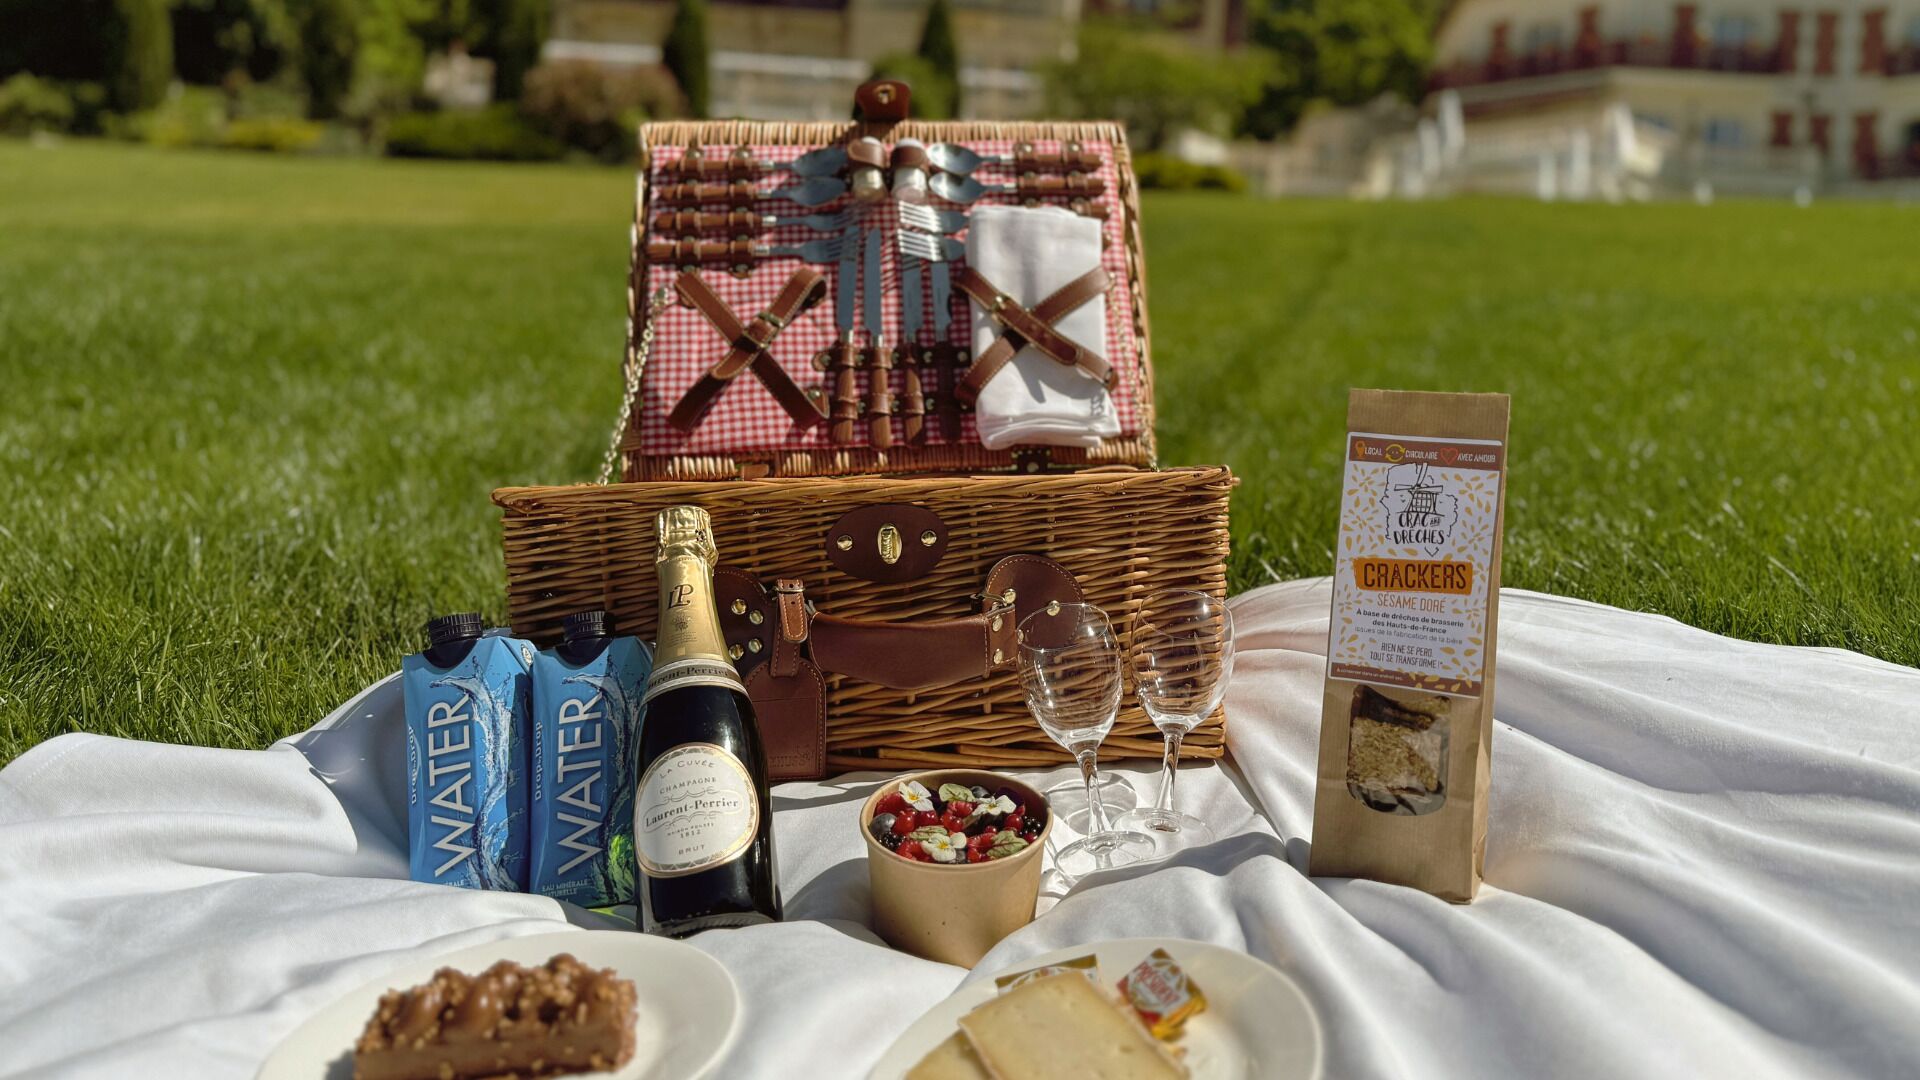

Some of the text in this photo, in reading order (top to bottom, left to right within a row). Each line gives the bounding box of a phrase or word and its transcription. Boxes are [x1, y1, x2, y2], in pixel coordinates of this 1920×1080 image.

[1364, 447, 1383, 456] LOCAL
[1405, 450, 1438, 460] CIRCULAIRE
[1457, 453, 1496, 463] AVEC AMOUR
[1398, 511, 1429, 528] CRAC
[1363, 562, 1467, 590] CRACKERS
[1377, 591, 1446, 614] SÉSAME DORÉ
[1363, 609, 1380, 618] base
[1431, 617, 1464, 628] brasserie
[1372, 619, 1447, 634] des Hauts-de-France
[1393, 630, 1428, 640] fabrication
[1381, 642, 1396, 653] RIEN
[1396, 644, 1406, 654] NE
[1406, 645, 1415, 655] SE
[1370, 651, 1385, 662] TOUT
[1386, 653, 1394, 663] SE
[1395, 654, 1437, 669] TRANSFORME
[535, 721, 543, 756] Drop
[659, 759, 715, 779] LA CUVÉE
[428, 693, 476, 877] WATER
[534, 765, 543, 801] Drop
[557, 693, 602, 876] WATER
[659, 776, 717, 794] CHAMPAGNE
[645, 798, 739, 828] Laurent-Perrier
[678, 844, 705, 855] BRUT
